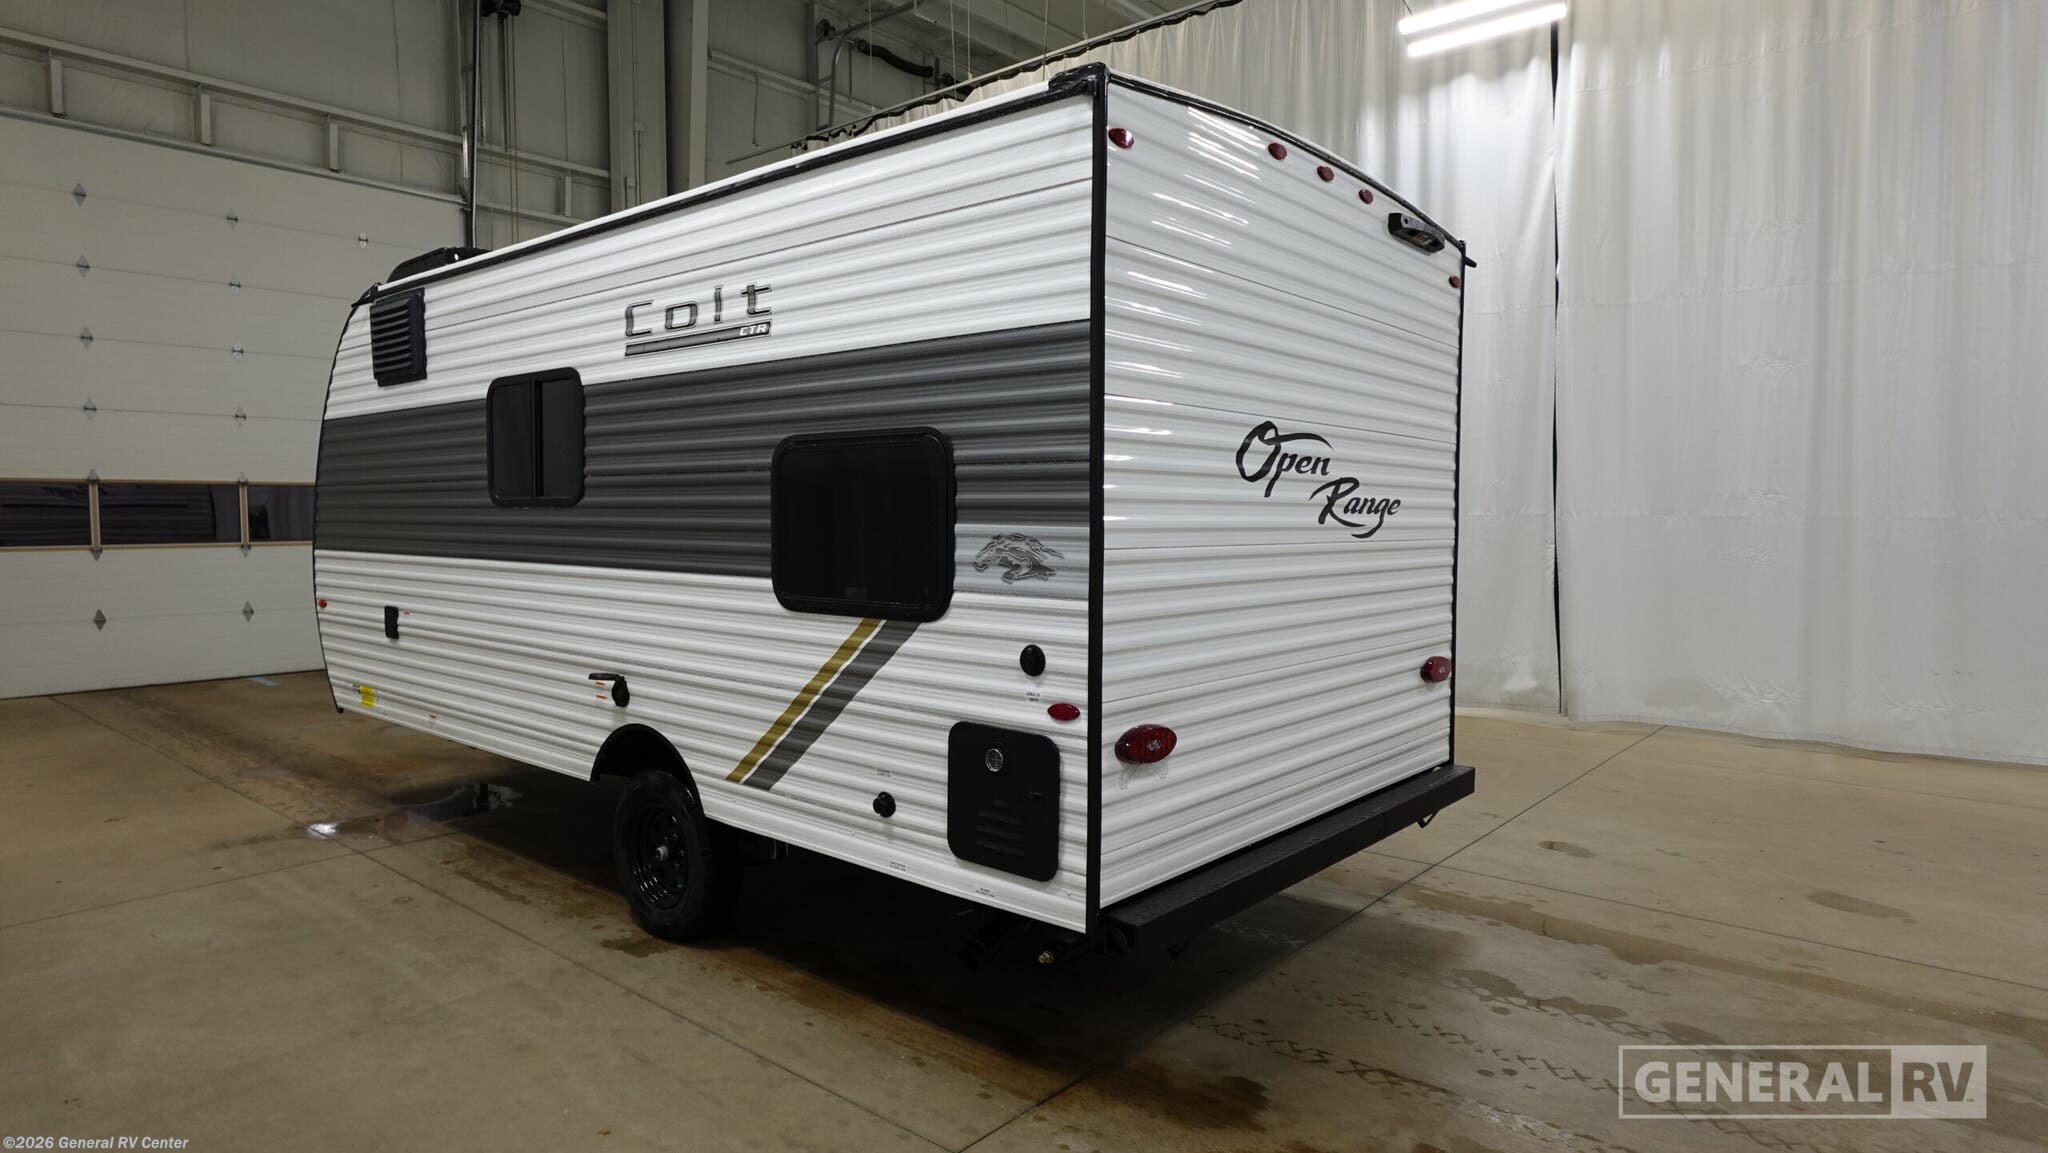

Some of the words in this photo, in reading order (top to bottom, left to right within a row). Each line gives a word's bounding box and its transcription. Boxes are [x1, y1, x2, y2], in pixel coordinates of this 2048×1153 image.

[625, 284, 772, 337] Colt
[739, 323, 767, 337] CTR
[1235, 420, 1334, 498] Open
[1309, 476, 1401, 539] Range
